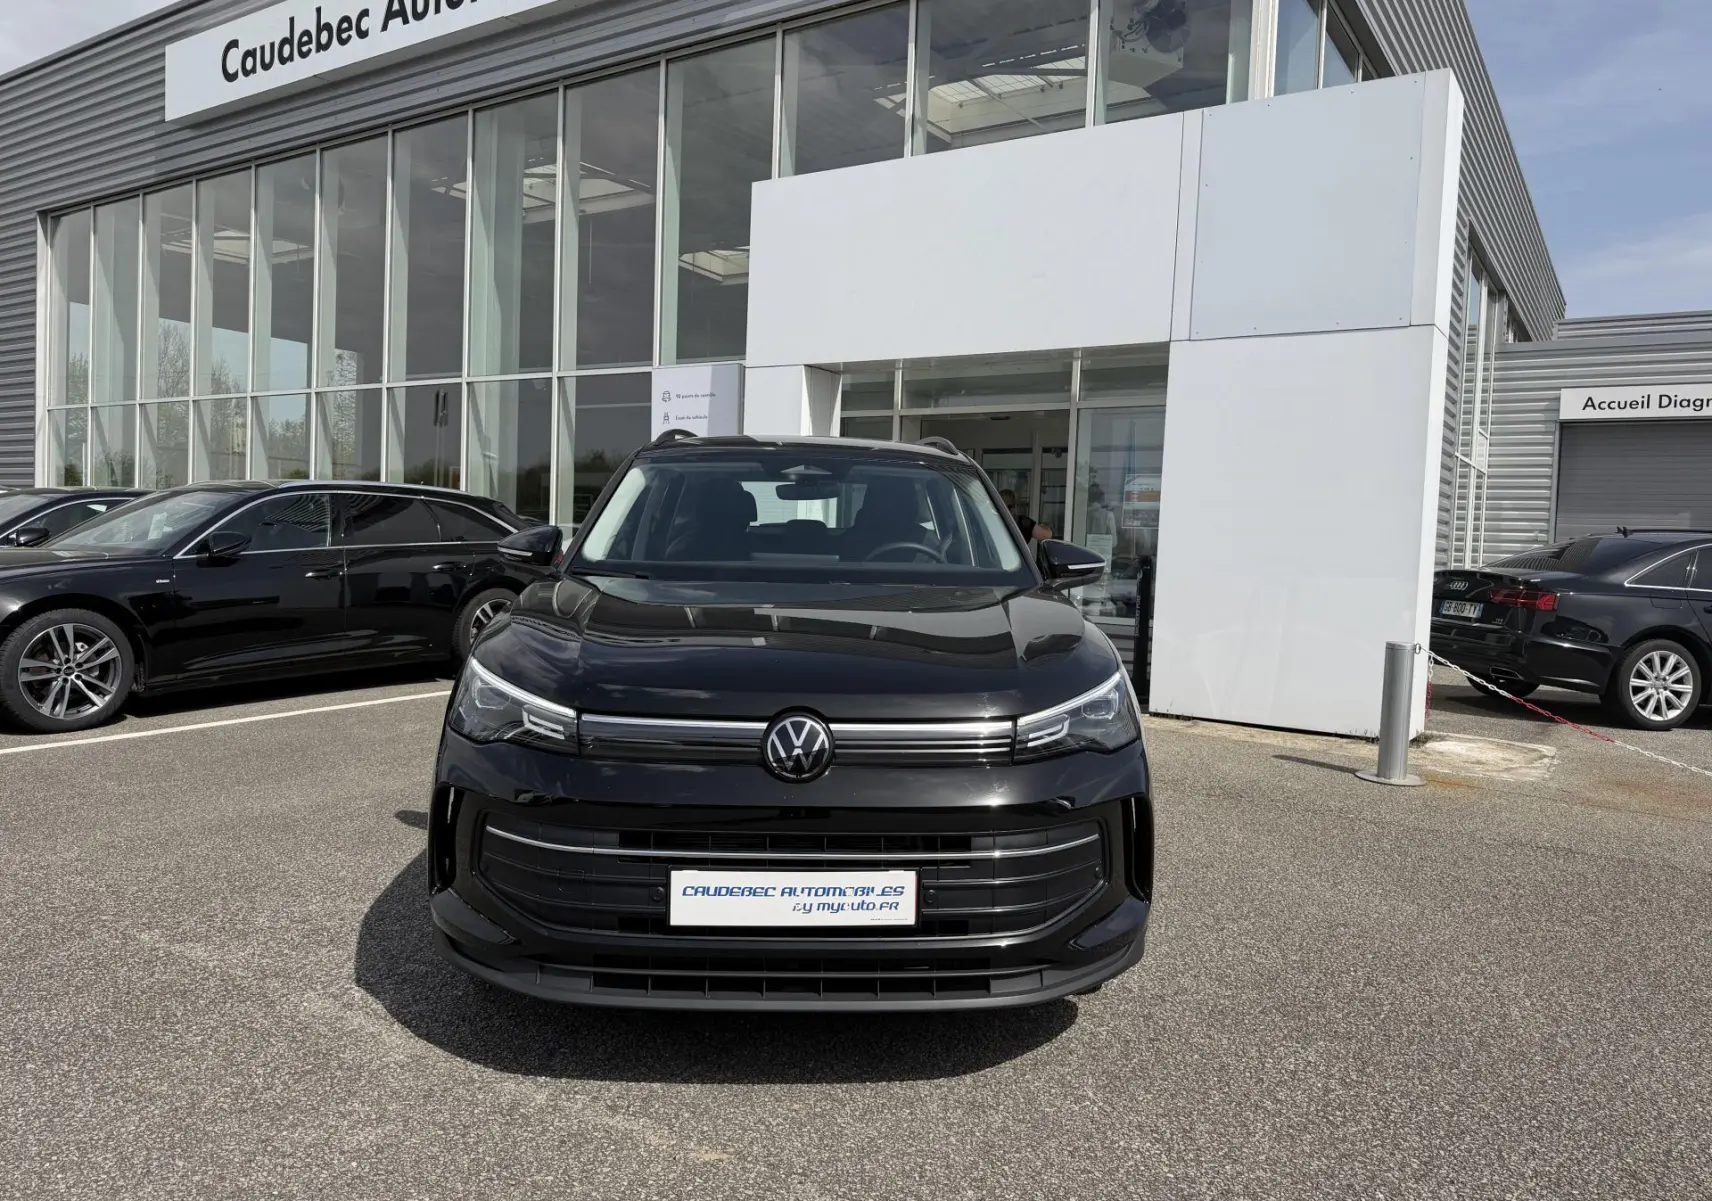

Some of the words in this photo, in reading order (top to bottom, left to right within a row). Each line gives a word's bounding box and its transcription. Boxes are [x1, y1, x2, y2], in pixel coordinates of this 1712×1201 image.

[221, 6, 370, 83] Caudebec
[1581, 394, 1651, 411] Accueil
[682, 885, 777, 897] CAUDEBEC
